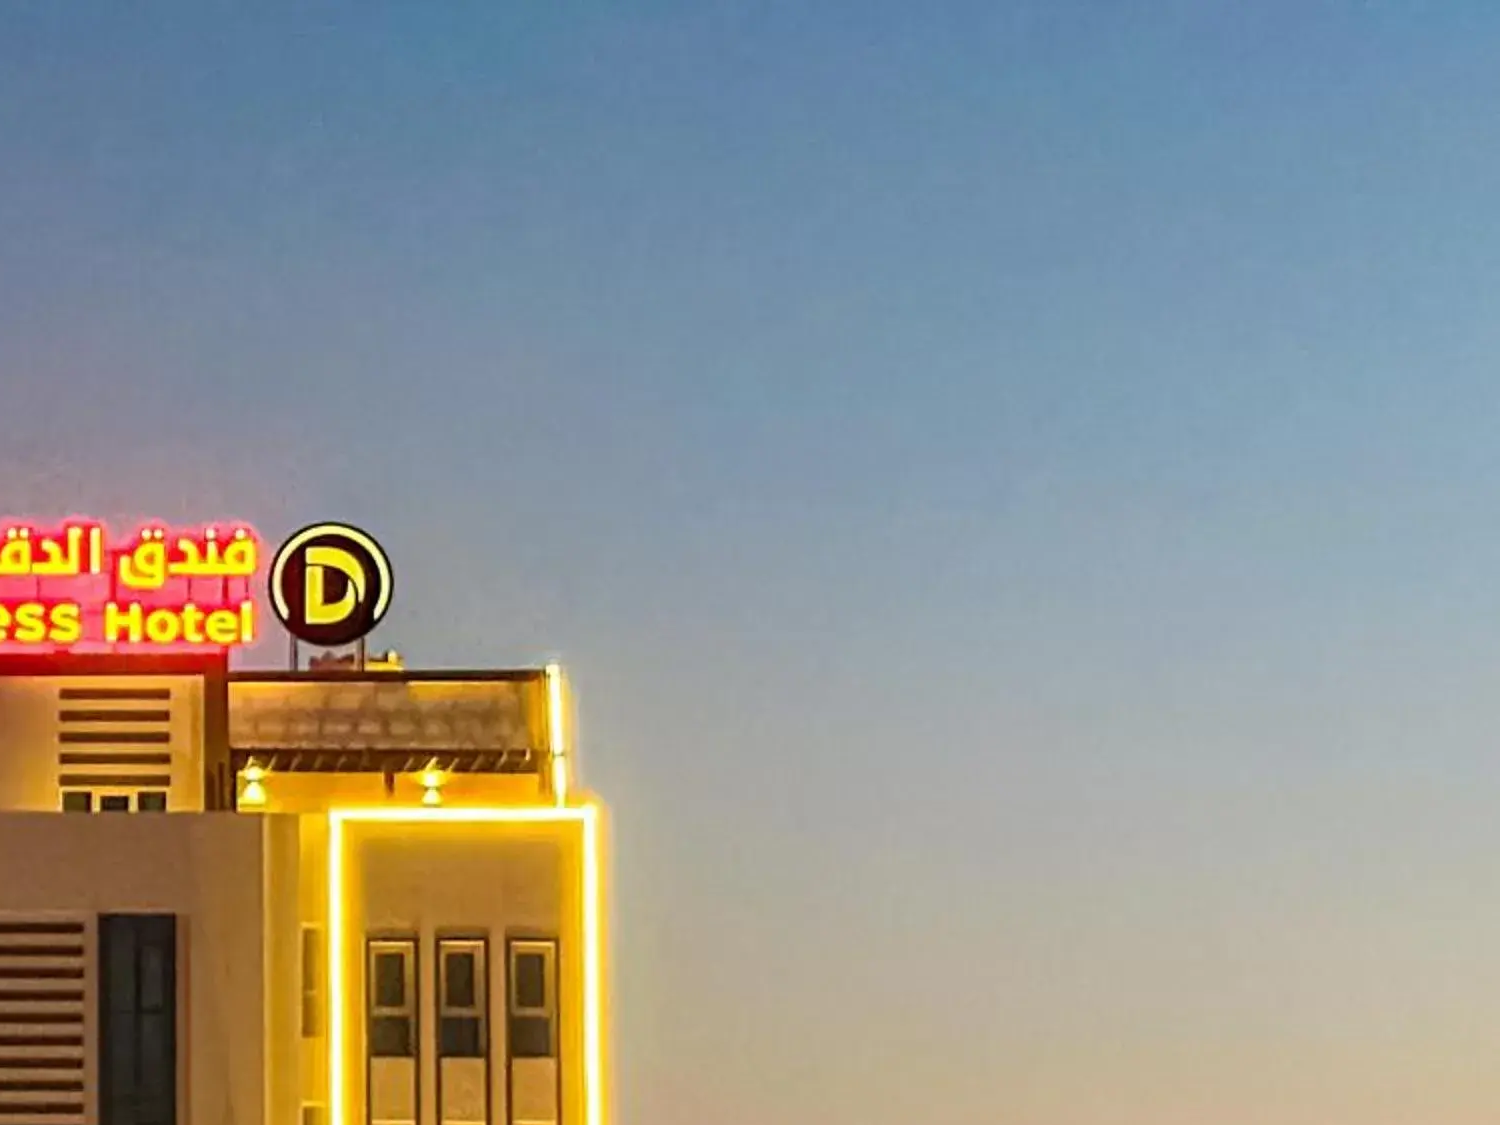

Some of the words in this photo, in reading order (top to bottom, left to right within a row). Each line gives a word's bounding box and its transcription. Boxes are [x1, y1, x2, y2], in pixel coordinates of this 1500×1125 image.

[119, 528, 257, 588] فندق
[305, 546, 367, 625] D
[105, 600, 253, 643] Hotel
